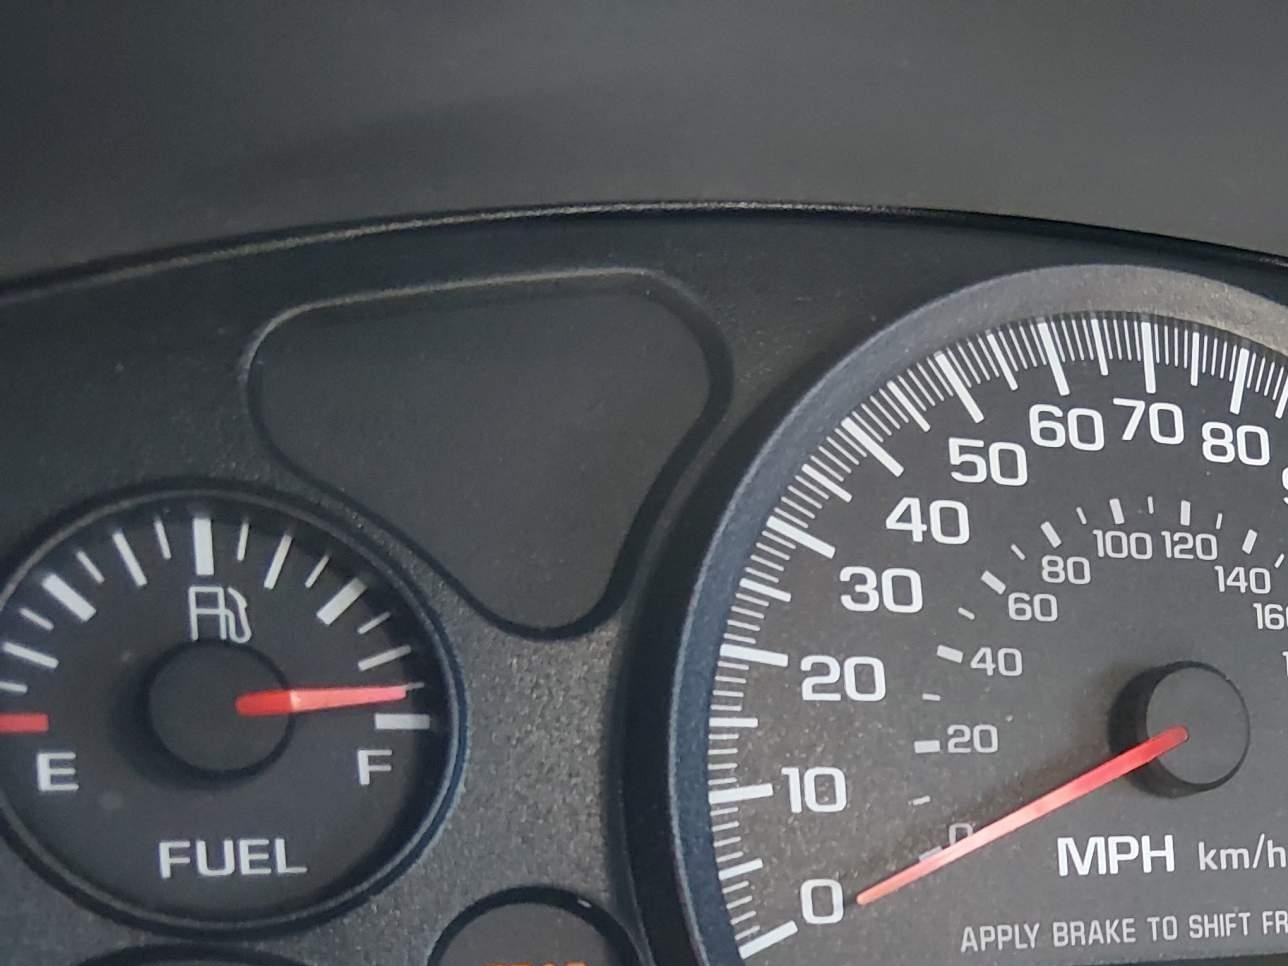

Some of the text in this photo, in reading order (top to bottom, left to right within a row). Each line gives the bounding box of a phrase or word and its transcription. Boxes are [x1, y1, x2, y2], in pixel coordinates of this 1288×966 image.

[1029, 403, 1104, 451] 60
[1113, 397, 1185, 445] 70
[948, 437, 1028, 487] 50
[1201, 421, 1270, 466] 80
[885, 497, 970, 544] 40
[1093, 529, 1153, 560] 100
[1161, 530, 1218, 561] 120
[839, 566, 923, 613] 30
[1041, 555, 1091, 585] 80
[1215, 566, 1271, 594] 140
[1007, 593, 1058, 622] 60
[800, 655, 885, 701] 20
[970, 647, 1023, 676] 40
[946, 724, 999, 753] 20
[36, 752, 79, 792] E
[356, 749, 393, 786] F
[781, 766, 847, 814] 10
[158, 838, 308, 879] FUEL
[1057, 833, 1287, 877] MPH km/h
[800, 879, 844, 925] 0
[960, 921, 1040, 953] APPLY
[1053, 917, 1137, 947] BRAKE
[1147, 915, 1179, 941] TO
[1189, 912, 1251, 939] SHIFT
